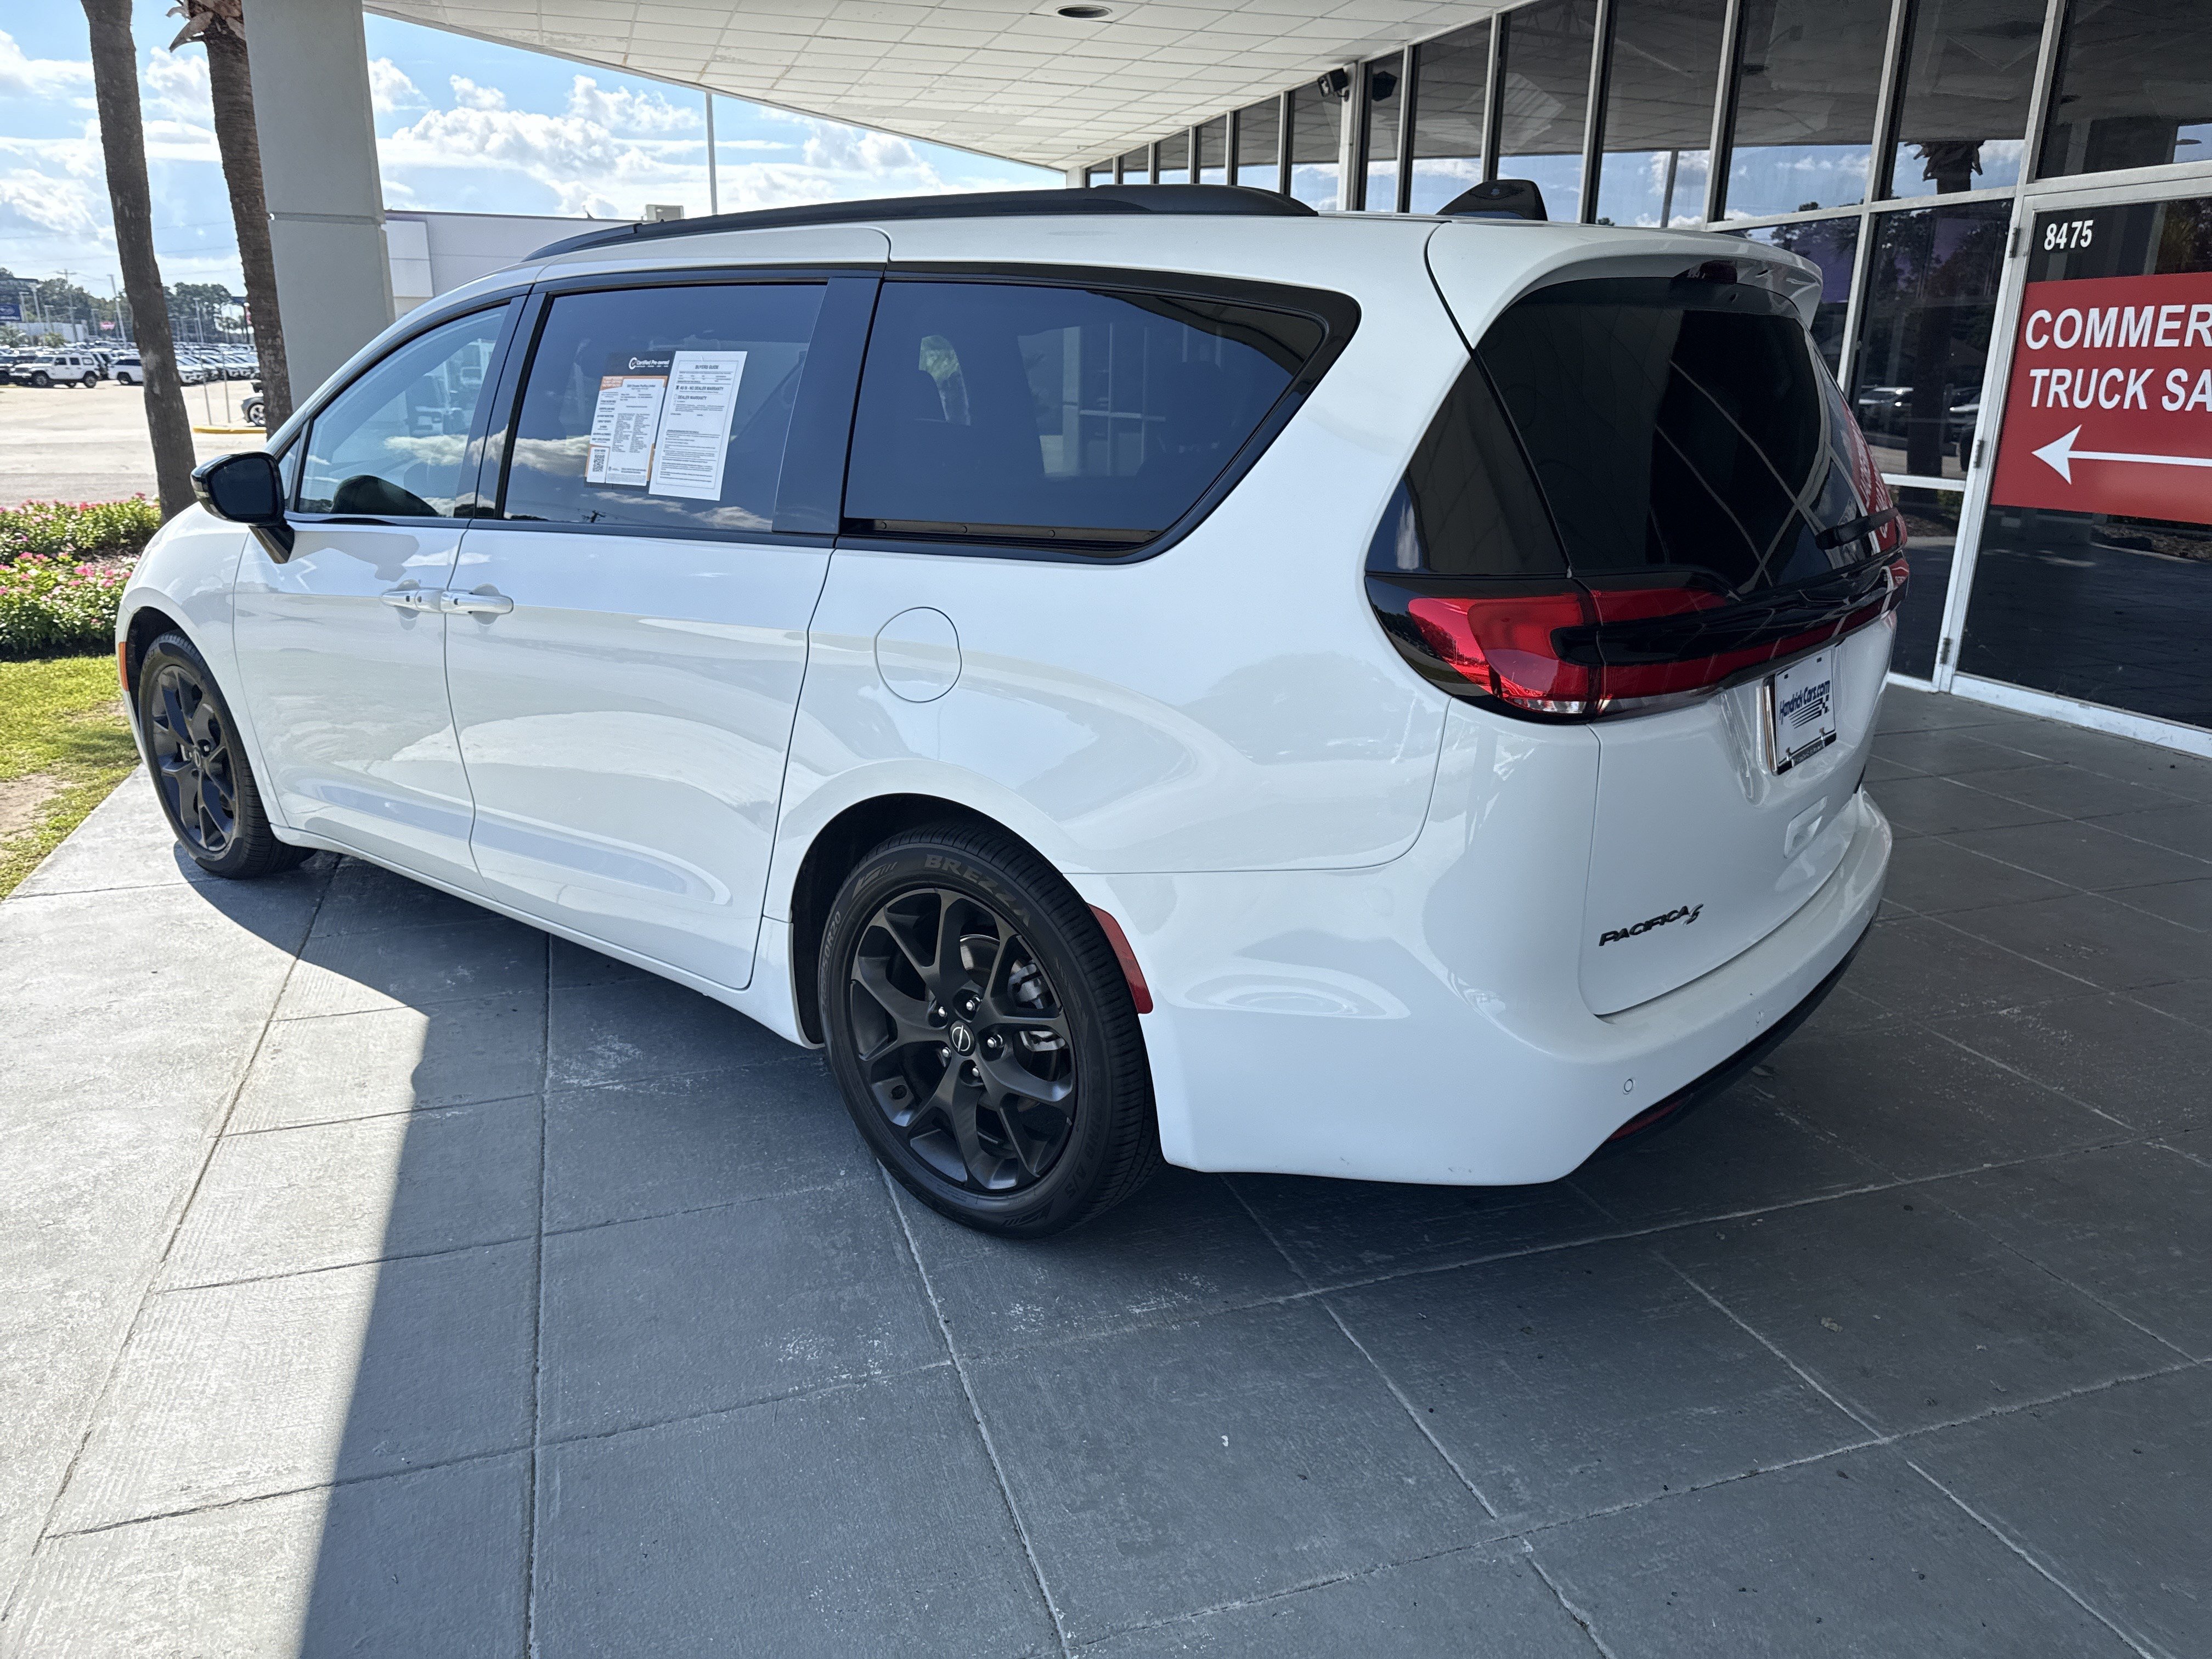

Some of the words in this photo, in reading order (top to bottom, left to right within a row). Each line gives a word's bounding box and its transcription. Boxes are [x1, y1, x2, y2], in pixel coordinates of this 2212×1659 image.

[2044, 219, 2093, 250] 8475
[2025, 304, 2212, 349] COMMER
[2030, 368, 2154, 410] TRUCK
[2162, 368, 2212, 411] SA
[1599, 906, 1689, 946] PACIFICA
